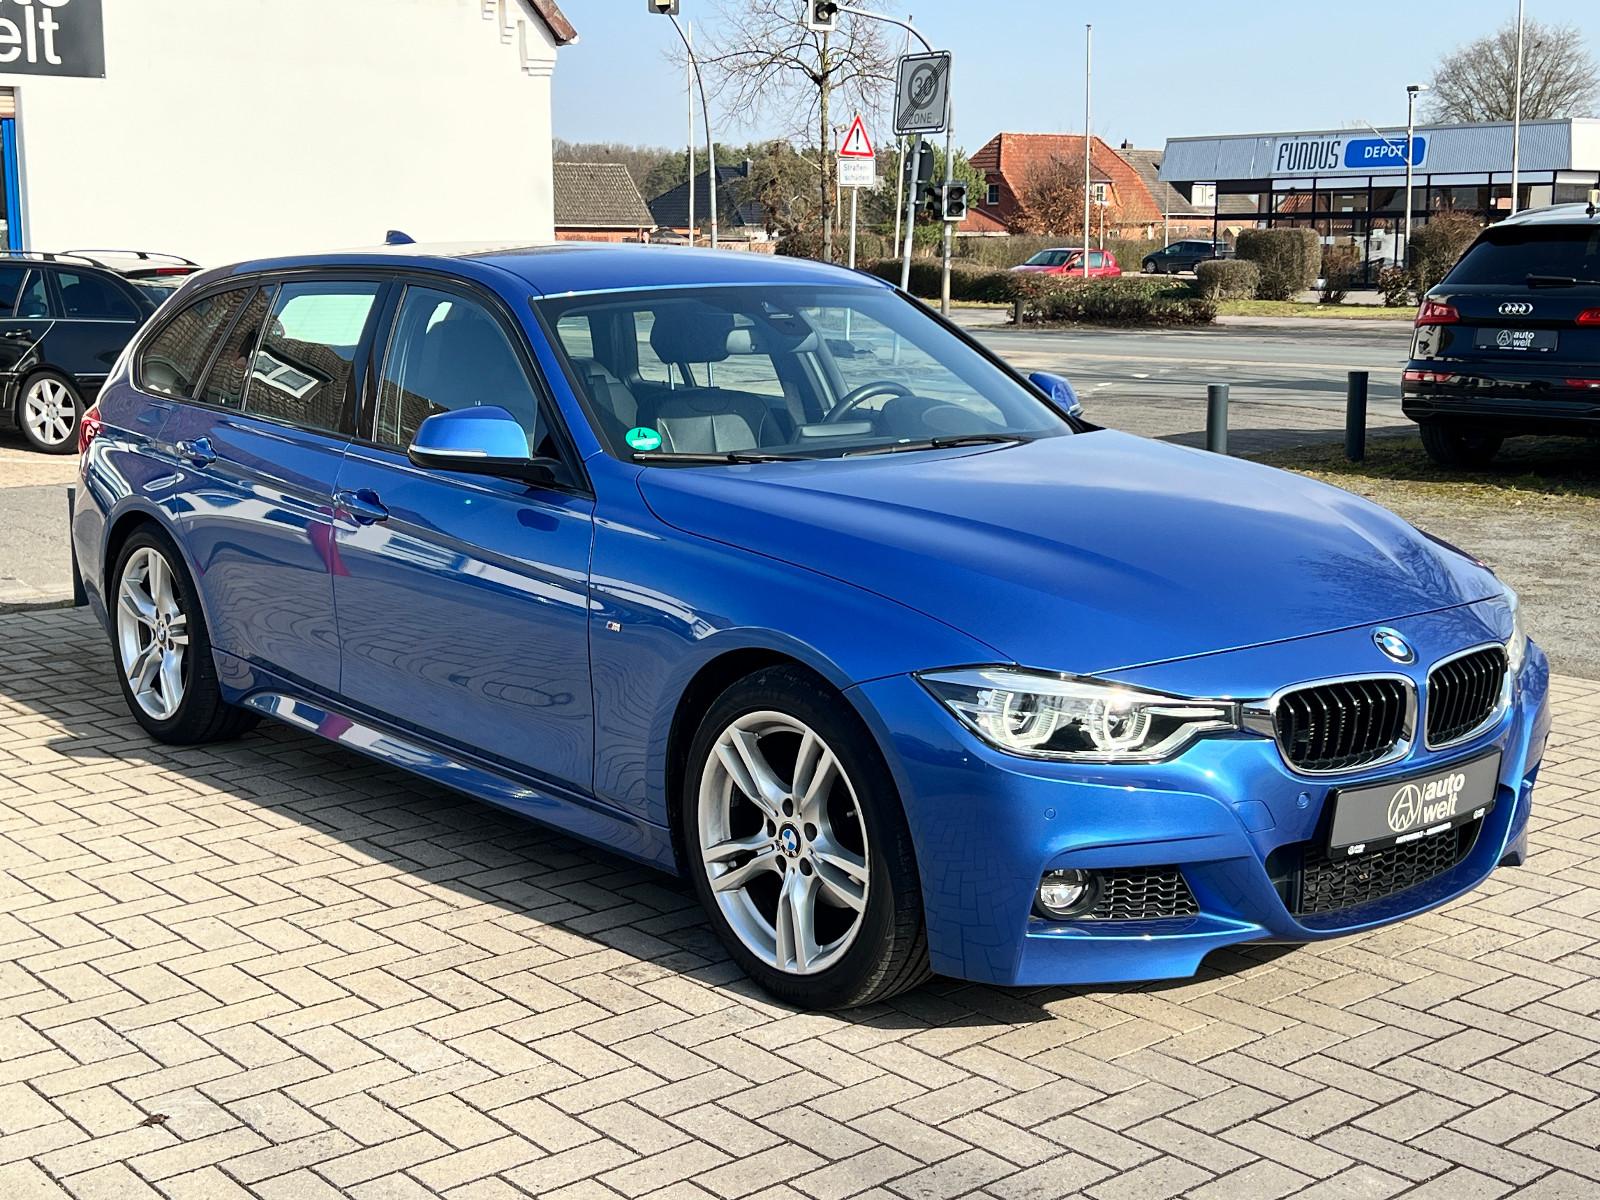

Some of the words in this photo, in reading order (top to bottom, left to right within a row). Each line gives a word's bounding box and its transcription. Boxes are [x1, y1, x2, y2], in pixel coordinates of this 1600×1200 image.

[914, 76, 934, 97] 30
[908, 112, 932, 125] ZONE
[1276, 140, 1341, 171] FUNDUS
[1364, 145, 1405, 159] DEPOT
[1513, 331, 1535, 339] auto
[1513, 338, 1531, 347] welt
[1425, 773, 1466, 801] auto
[1423, 792, 1458, 824] welt
